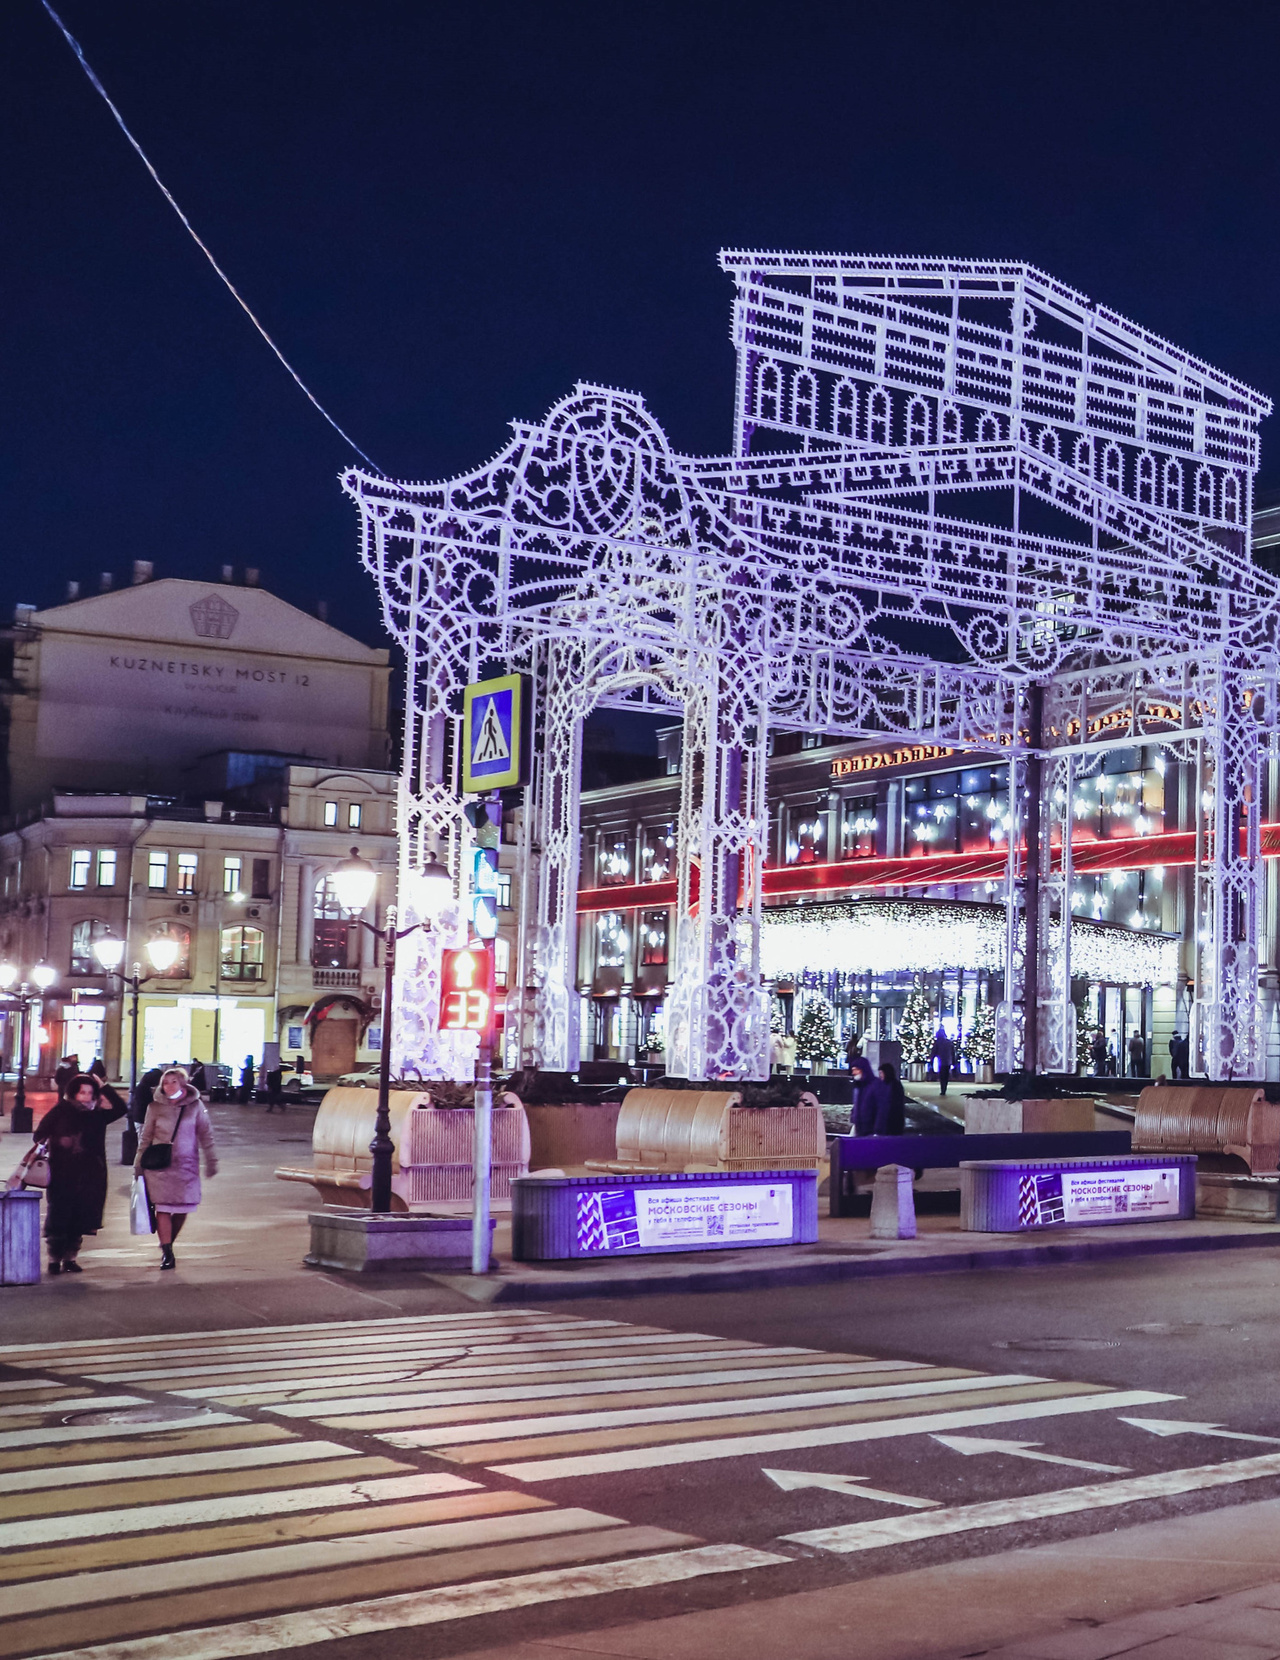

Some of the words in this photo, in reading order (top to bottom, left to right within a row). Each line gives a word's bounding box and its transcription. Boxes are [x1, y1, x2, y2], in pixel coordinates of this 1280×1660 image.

[110, 656, 224, 677] KUZNETSKY
[236, 669, 287, 684] MOST
[295, 675, 310, 687] 12
[830, 746, 950, 776] ЦЕНТРАЛЬНЫЙ
[447, 989, 490, 1028] 33
[1071, 1186, 1121, 1195] МОСКОВСКИЕ
[1123, 1184, 1153, 1192] СЕЗОНЫ
[648, 1204, 715, 1215] МОСКОВСКИЕ
[718, 1202, 758, 1212] СЕЗОНЫ
